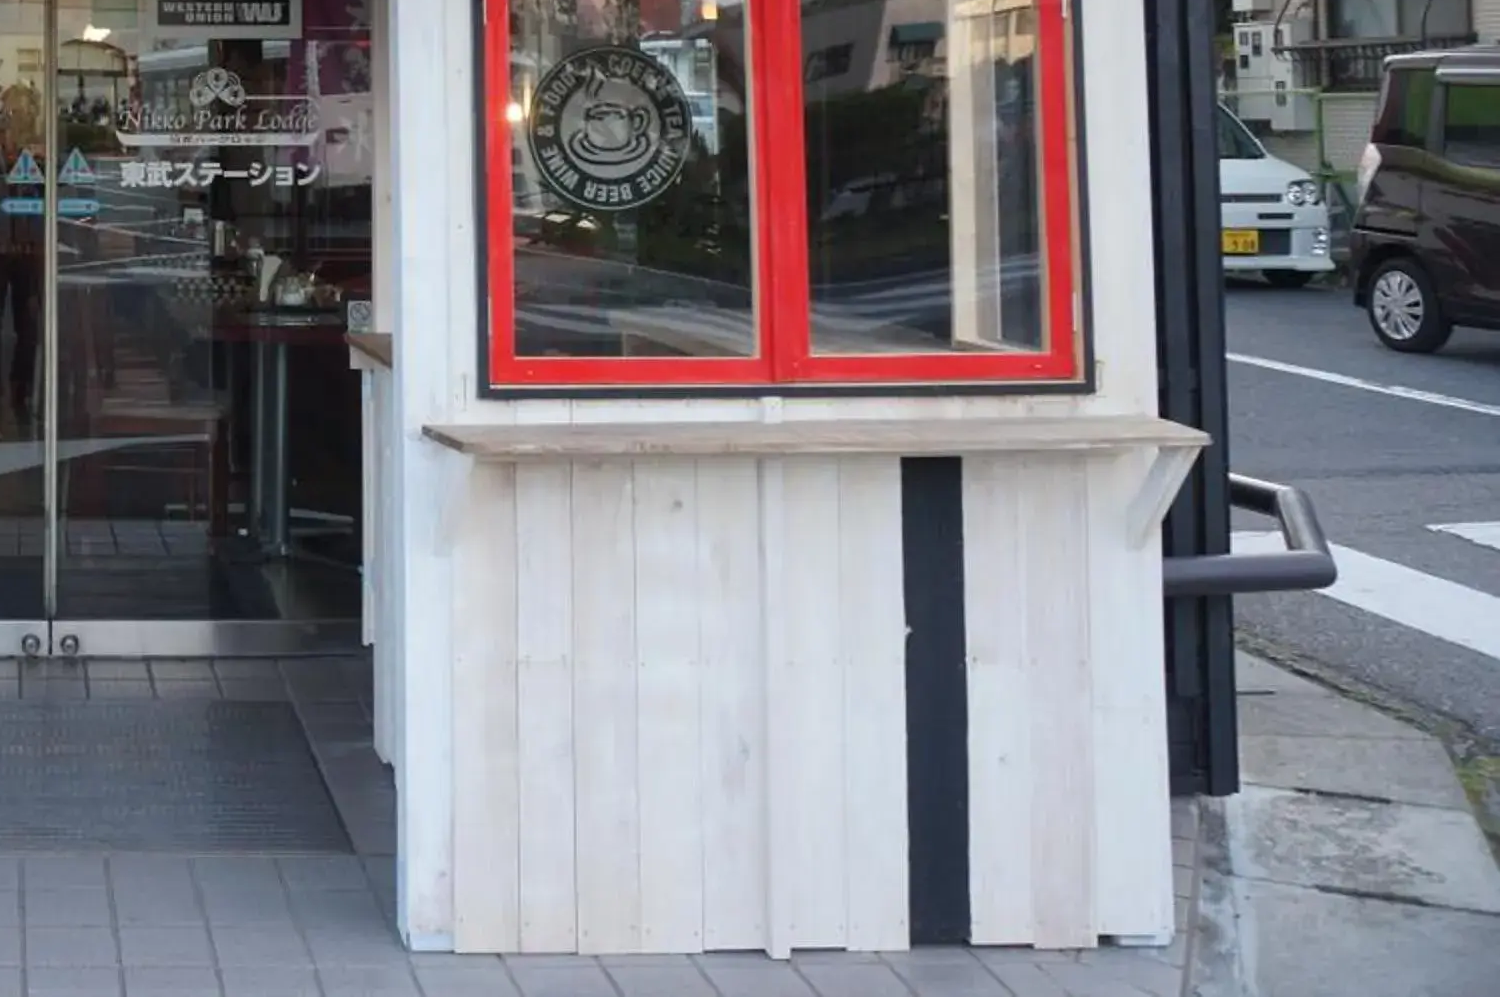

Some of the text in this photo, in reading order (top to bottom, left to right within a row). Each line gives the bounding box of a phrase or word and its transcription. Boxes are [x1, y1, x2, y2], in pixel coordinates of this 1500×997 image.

[163, 1, 234, 13] WESTERN
[184, 12, 234, 23] UNION
[118, 104, 316, 138] Nikko Park Lodge
[537, 123, 554, 138] &
[664, 104, 684, 139] TEA
[120, 160, 321, 187] 東武ステーション
[541, 143, 580, 190] WINE
[636, 145, 678, 193] JUICE
[583, 180, 633, 203] BEER
